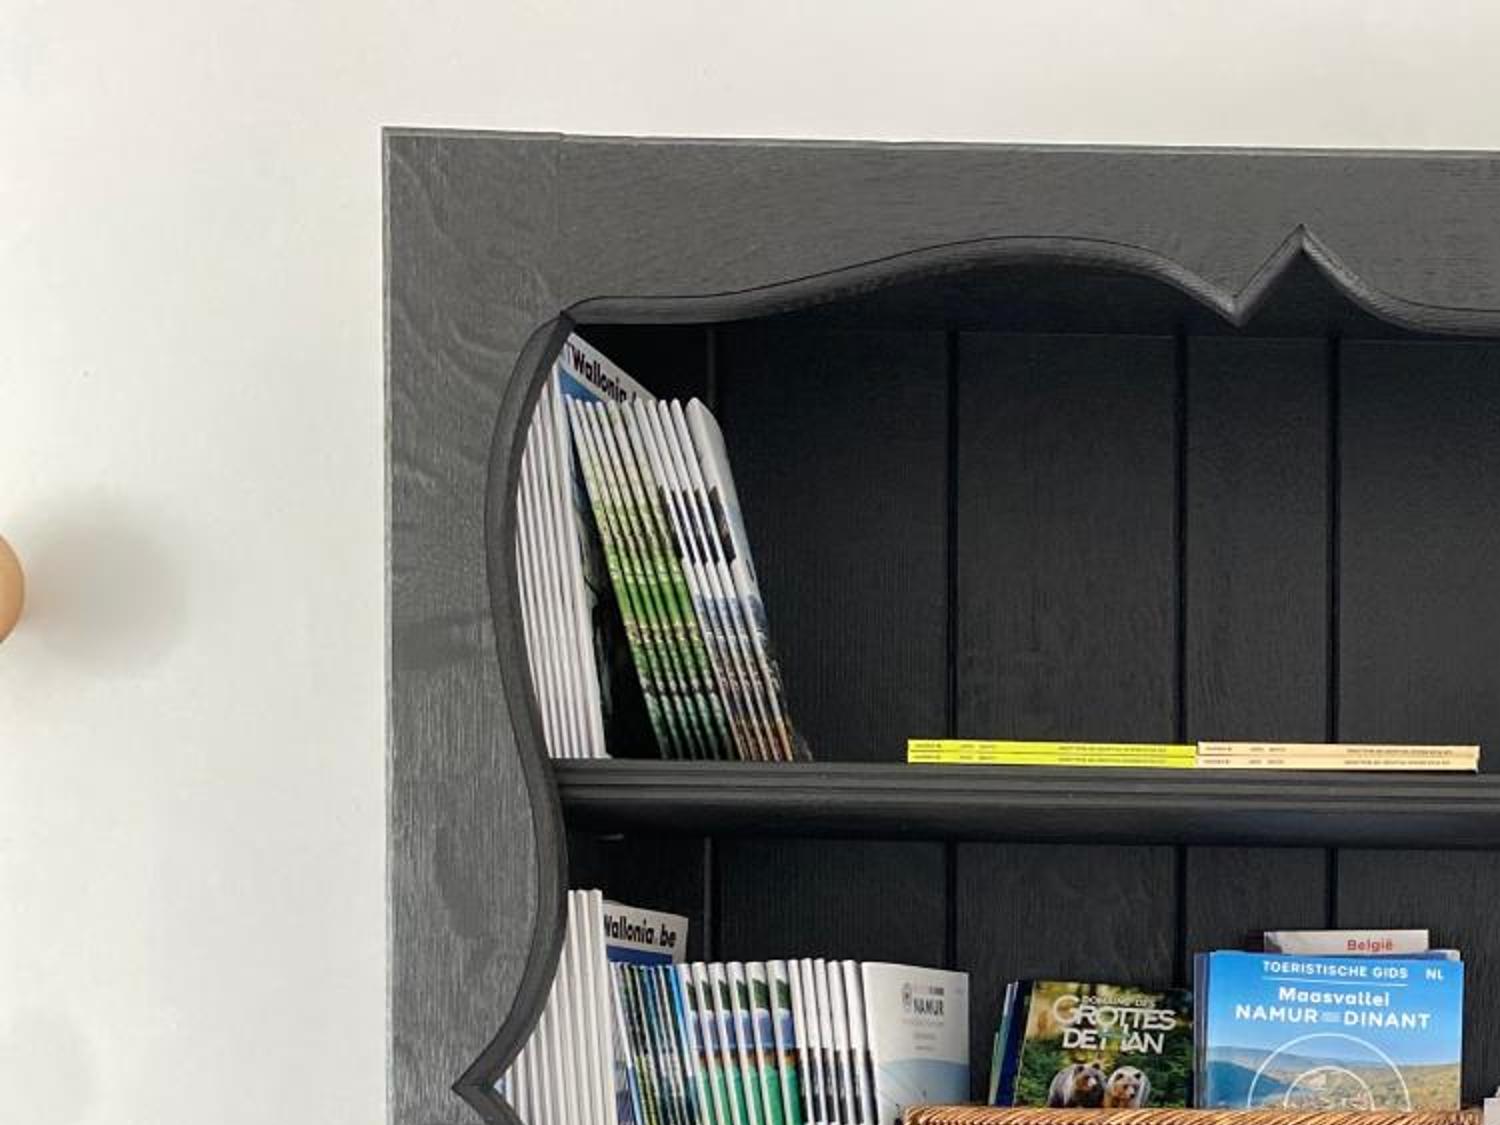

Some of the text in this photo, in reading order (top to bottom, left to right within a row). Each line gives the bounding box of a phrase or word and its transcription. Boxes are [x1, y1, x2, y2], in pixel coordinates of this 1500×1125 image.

[1347, 938, 1393, 951] België
[1262, 960, 1445, 980] TOERISTISCHE GIDS NL
[1278, 986, 1390, 1007] Maasvallei
[1053, 994, 1177, 1031] GROTTES
[1234, 1003, 1431, 1029] NAMUR DINANT
